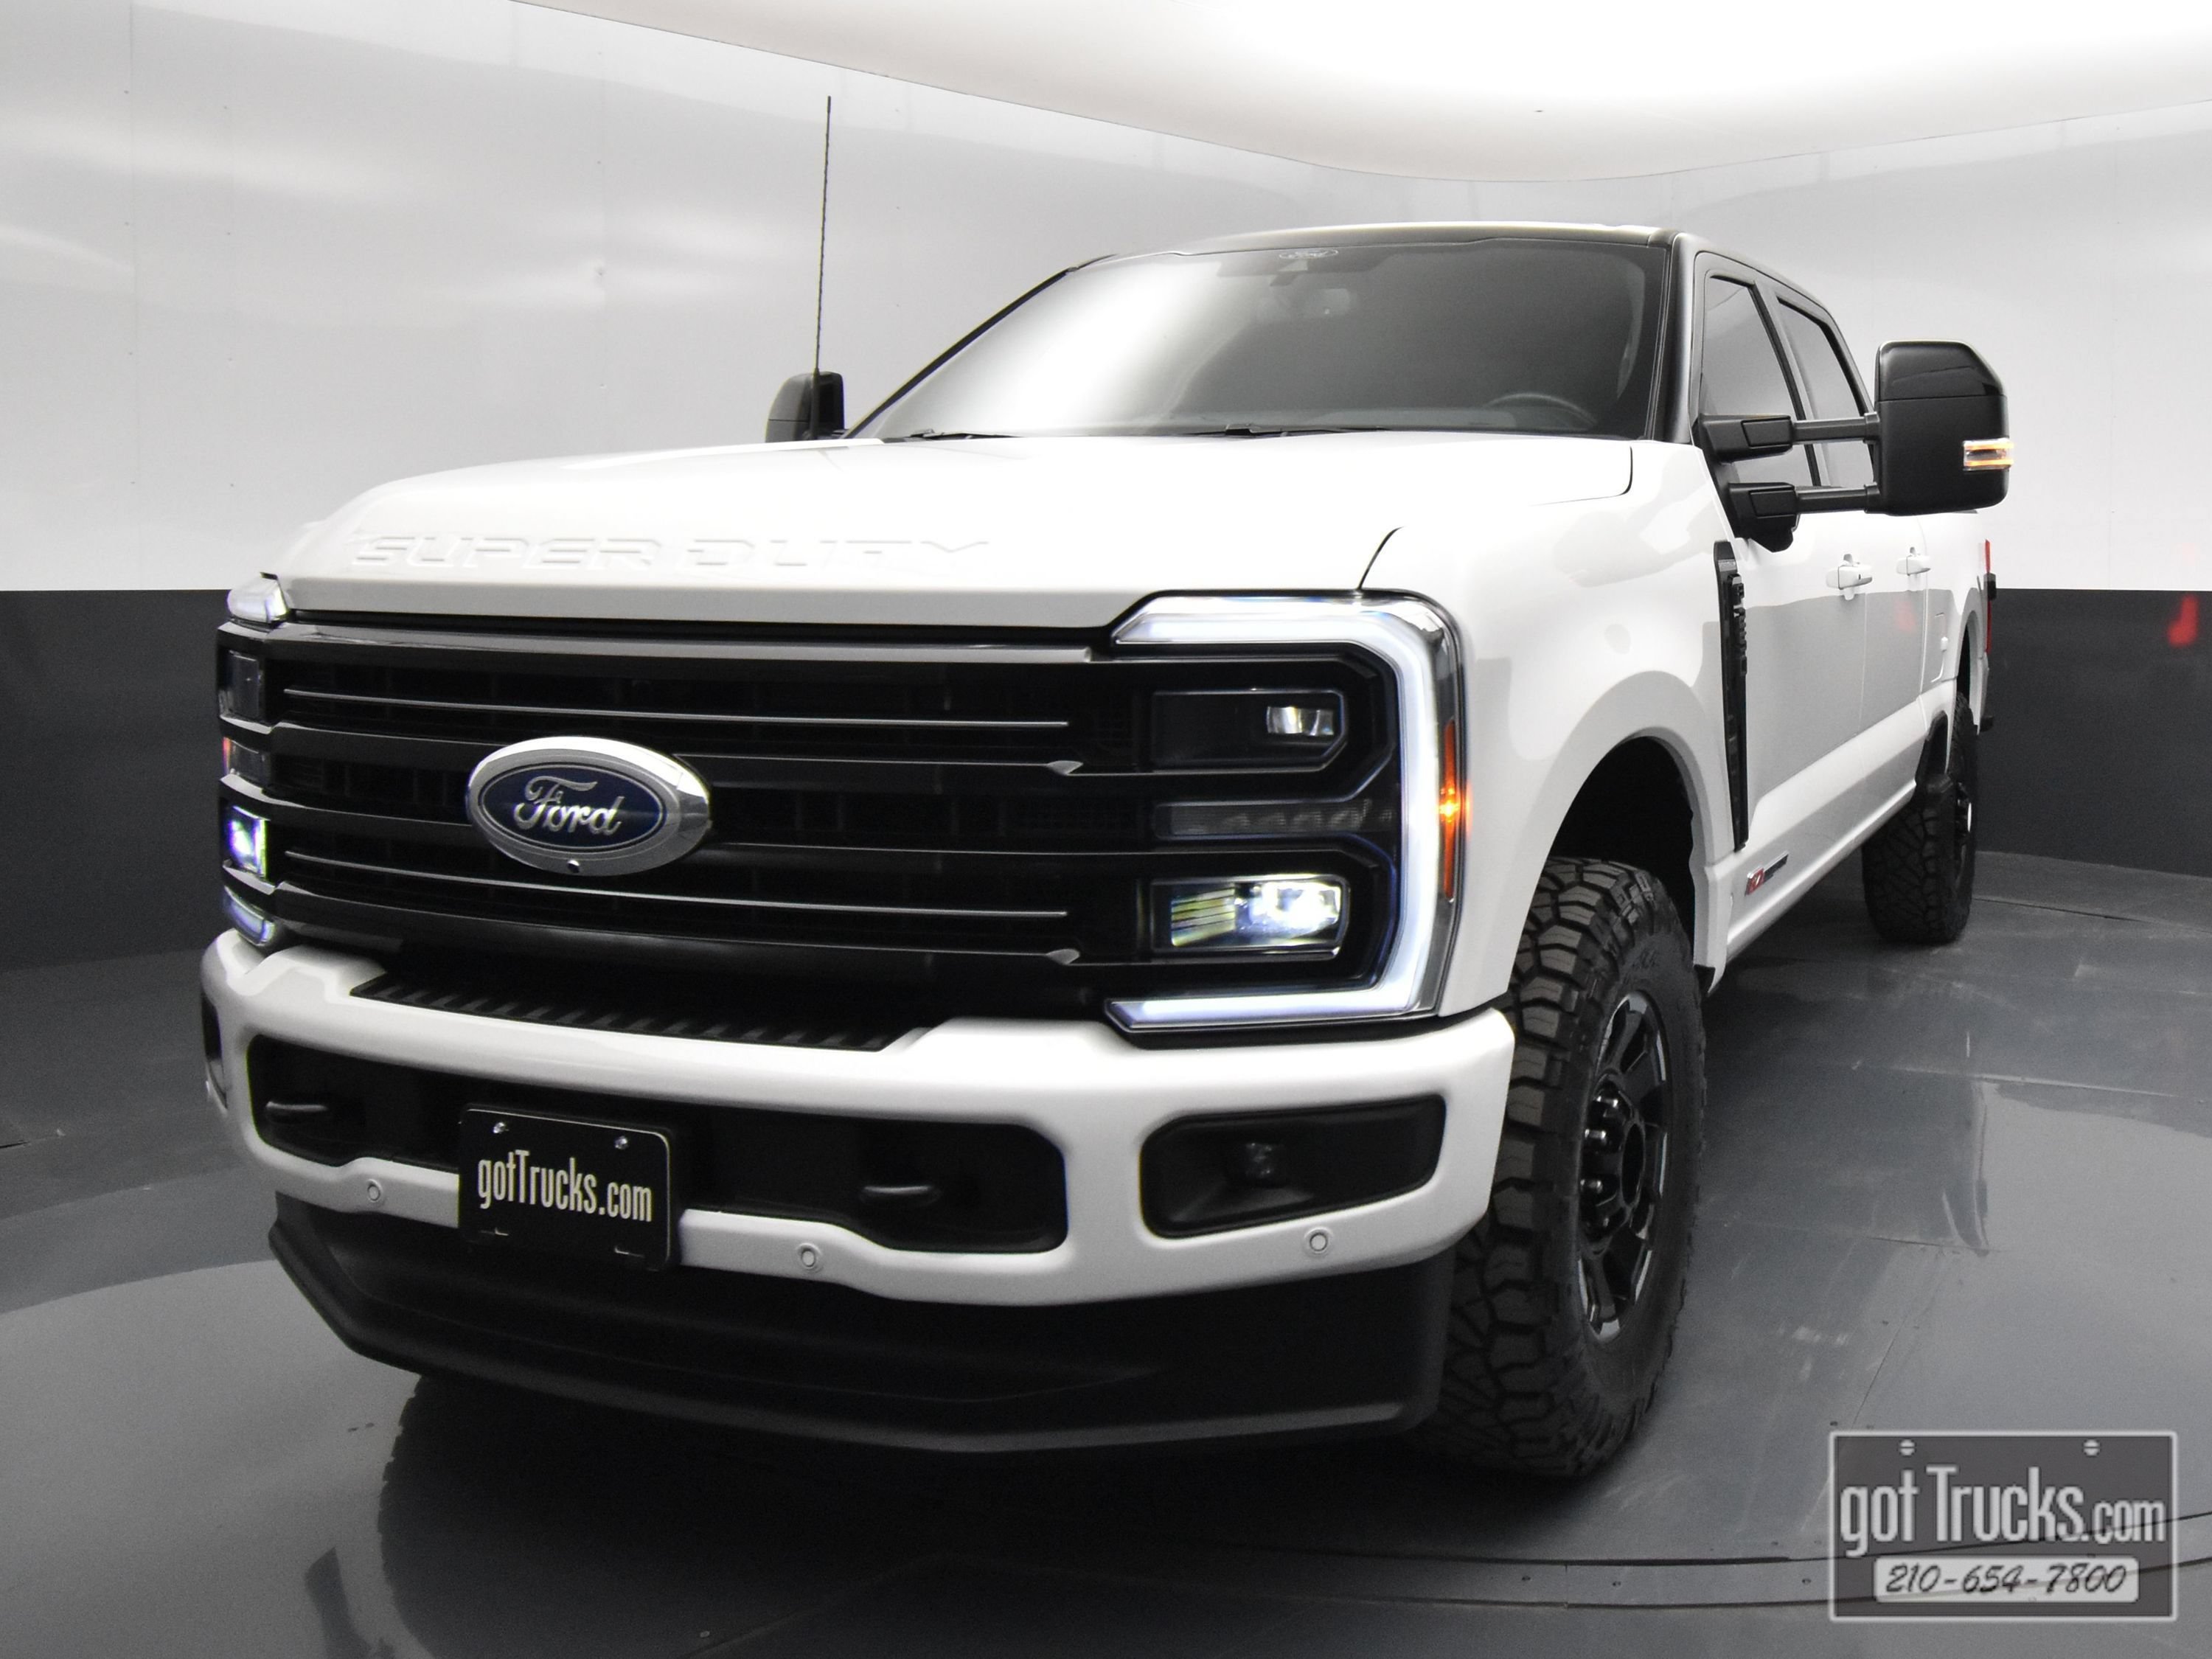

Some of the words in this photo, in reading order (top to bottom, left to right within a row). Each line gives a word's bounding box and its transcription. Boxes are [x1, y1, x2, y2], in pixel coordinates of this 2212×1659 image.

[352, 535, 662, 569] SUPER
[513, 776, 625, 835] Ford
[478, 1149, 653, 1222] gotTrucks.com
